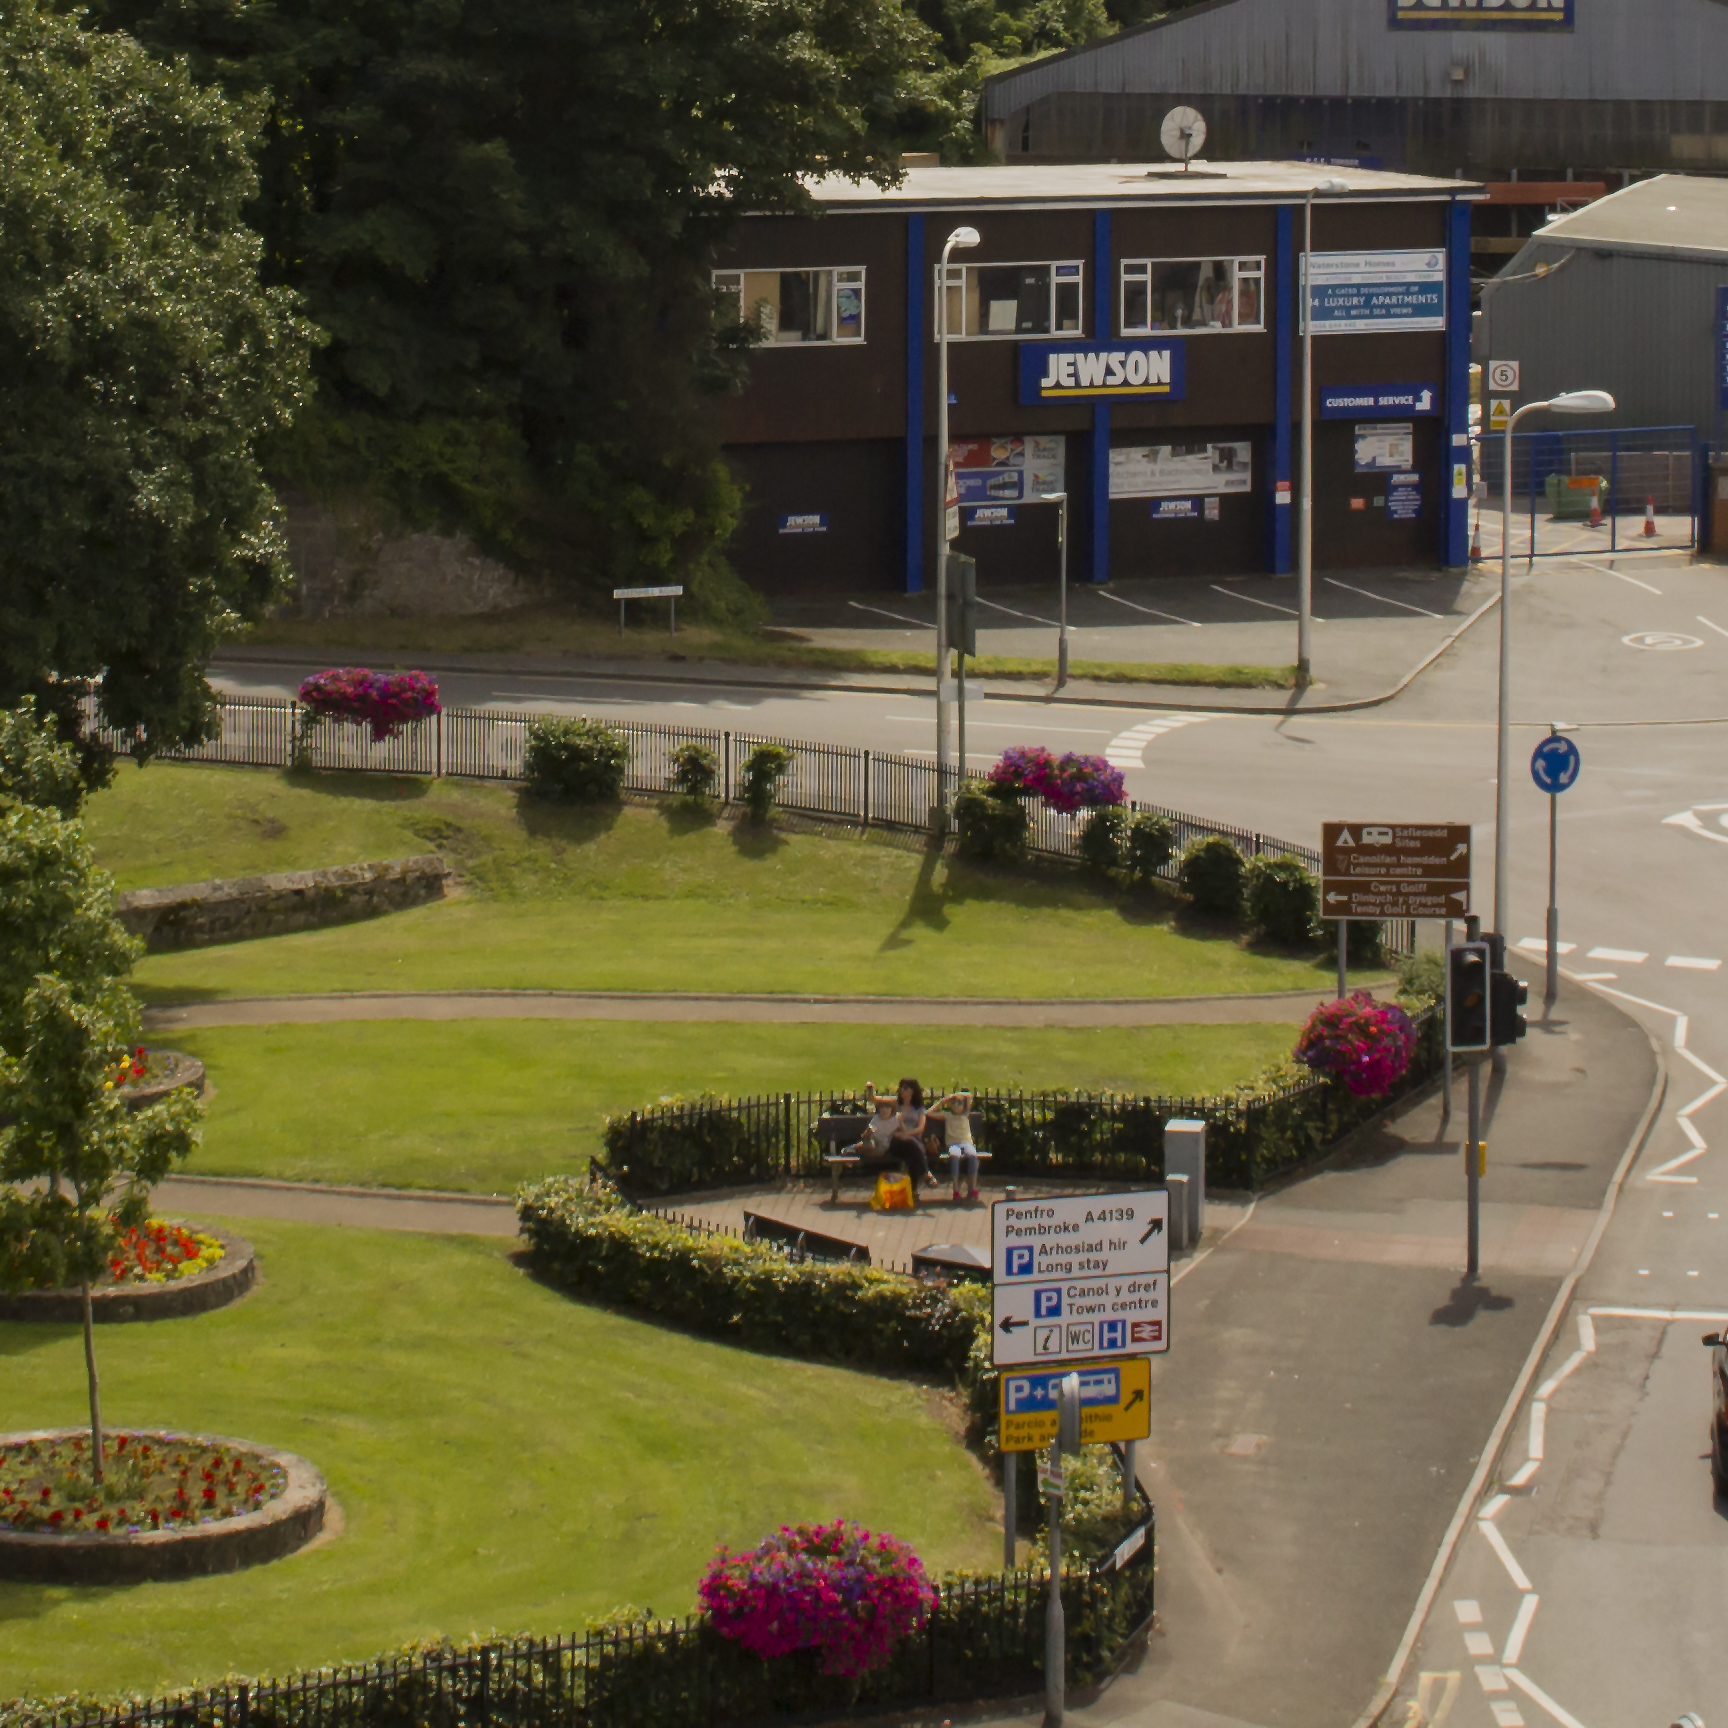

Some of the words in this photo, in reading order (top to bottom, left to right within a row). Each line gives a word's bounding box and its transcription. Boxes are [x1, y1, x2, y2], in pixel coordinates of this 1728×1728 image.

[1364, 259, 1396, 268] Homes
[1336, 287, 1358, 295] GATED
[1360, 285, 1406, 294] DEVELOPMENT
[1325, 296, 1365, 307] LUXURY
[1371, 293, 1438, 305] APARTMENTS
[1334, 309, 1346, 317] ALL
[1350, 308, 1370, 316] WITH
[1373, 308, 1386, 316] SEA
[1390, 307, 1413, 315] VIEWS
[1041, 349, 1171, 388] JEWSON
[1499, 369, 1509, 383] 5
[1326, 397, 1375, 407] CUSTOMER
[1378, 395, 1414, 406] SERVICE
[1032, 452, 1058, 461] TRADE
[1159, 500, 1192, 512] JEWSON
[974, 508, 1008, 519] JEWSON
[1395, 827, 1448, 838] Safleoedd
[1395, 837, 1421, 848] Sites
[1350, 853, 1397, 864] Canolfan
[1400, 854, 1448, 865] hamdden
[1350, 864, 1387, 875] Leisure
[1389, 866, 1423, 876] centre
[1371, 882, 1397, 893] Cwrs
[1400, 883, 1427, 894] Golff
[1351, 904, 1382, 915] Tenby
[1384, 904, 1407, 915] Golf
[1410, 905, 1447, 915] Course
[1005, 1206, 1056, 1222] Penfro
[1084, 1206, 1136, 1224] A4139
[1005, 1222, 1081, 1239] Pembroke
[1108, 1238, 1129, 1252] hir
[1012, 1248, 1030, 1274] P
[1038, 1259, 1073, 1276] Long
[1078, 1257, 1109, 1273] stay
[1066, 1281, 1110, 1299] Canol
[1114, 1284, 1123, 1298] y
[1127, 1278, 1158, 1294] dref
[1041, 1290, 1058, 1316] P
[1066, 1301, 1106, 1316] Town
[1111, 1297, 1160, 1313] centre
[1069, 1328, 1092, 1346] WC
[1103, 1322, 1123, 1349] H
[1005, 1416, 1049, 1432] Parcio
[1005, 1432, 1035, 1446] Park
